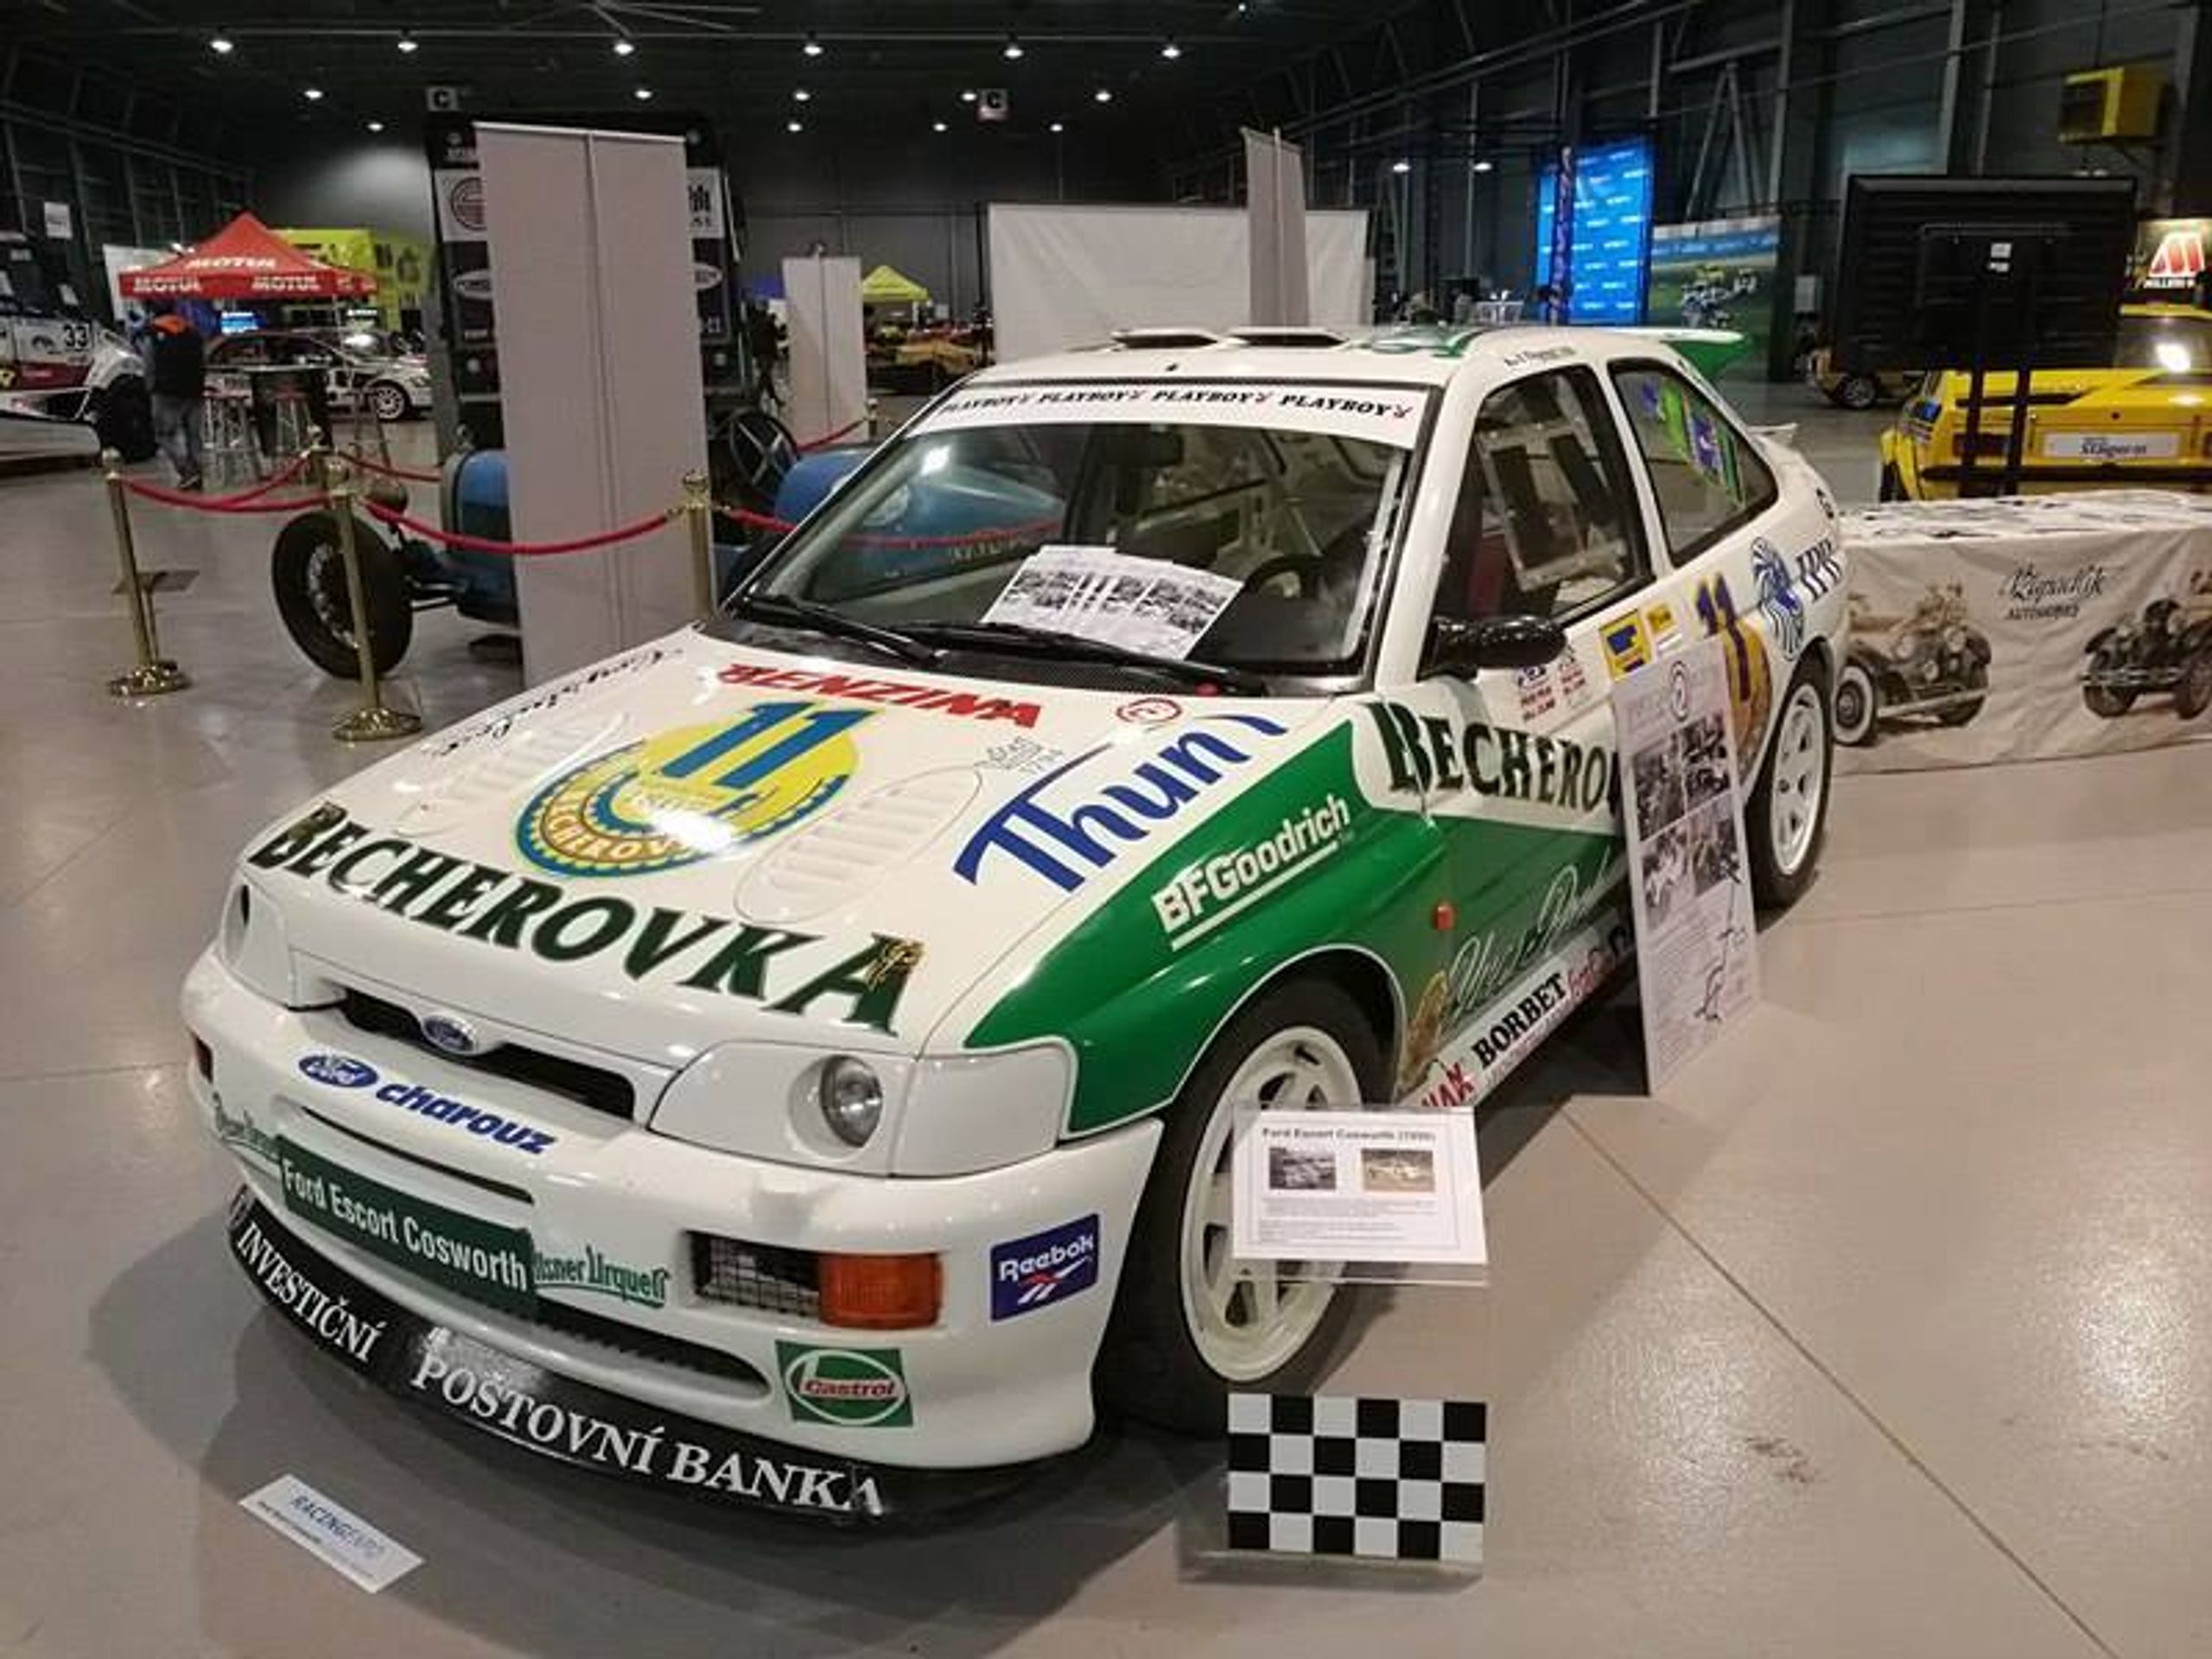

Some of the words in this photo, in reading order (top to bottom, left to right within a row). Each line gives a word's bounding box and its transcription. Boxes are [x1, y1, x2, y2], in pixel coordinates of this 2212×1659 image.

[133, 276, 202, 292] MOTUL
[251, 275, 321, 291] MOTUL
[64, 323, 89, 347] 33
[1039, 390, 1128, 404] PLAYBOY
[1152, 389, 1255, 404] PLAYBOY
[1279, 394, 1391, 417] PLAYBOY
[717, 664, 1040, 728] BENZINA
[660, 701, 878, 789] 11
[1151, 793, 1351, 934] BFGoodrich
[248, 799, 923, 1037] BECHEROVKA
[1471, 973, 1567, 1069] BORBET
[376, 1084, 556, 1154] charouz
[282, 1158, 327, 1210] Ford
[328, 1182, 400, 1244] Escort
[403, 1216, 527, 1292] Cosworth
[998, 1234, 1095, 1283] Reebok
[236, 1222, 386, 1363] INVESTIČNÍ
[804, 1377, 896, 1396] Castrol
[411, 1354, 665, 1469] POŠTOVNÍ
[666, 1442, 884, 1517] BANKA
